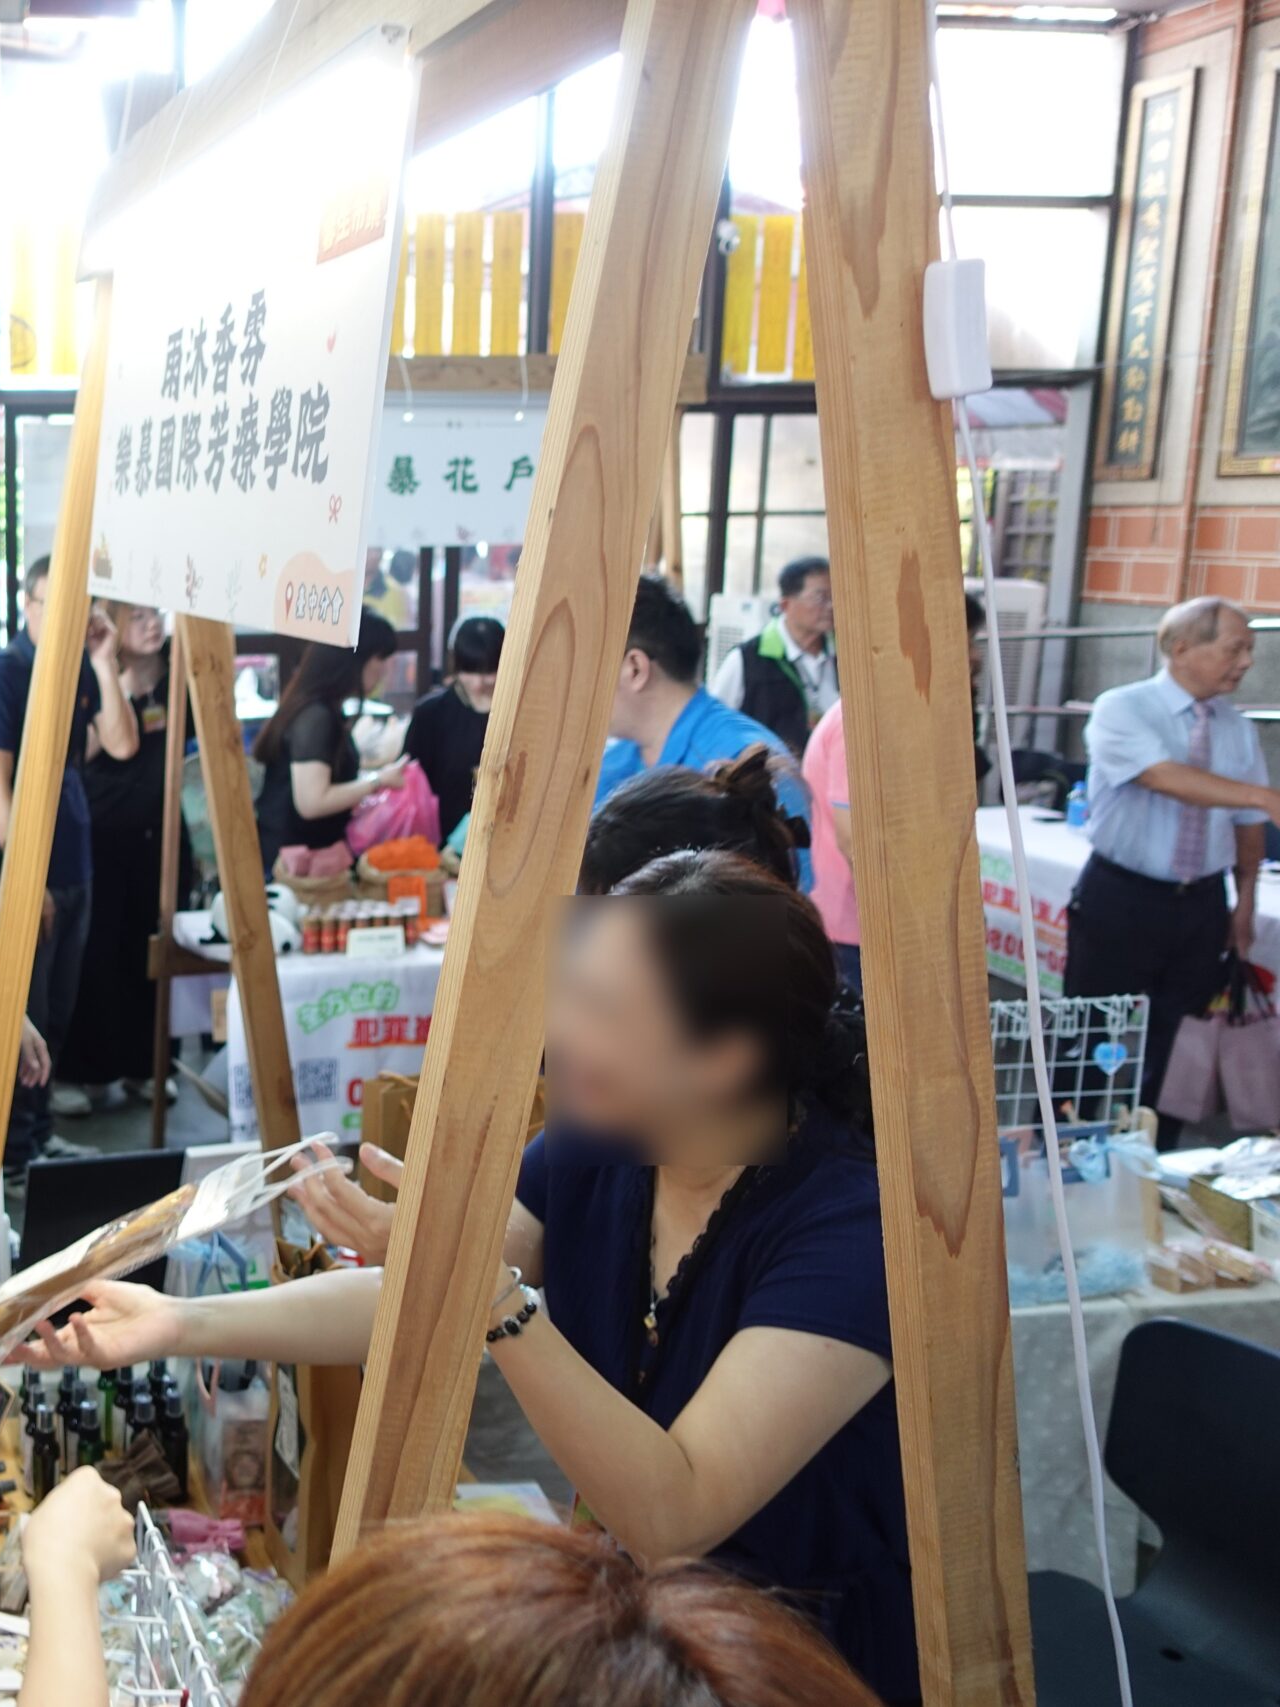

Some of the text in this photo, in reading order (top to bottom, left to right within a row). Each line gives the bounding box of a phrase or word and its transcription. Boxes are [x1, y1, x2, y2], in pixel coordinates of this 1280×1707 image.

[115, 380, 330, 497] 樂慕國際芳療學院
